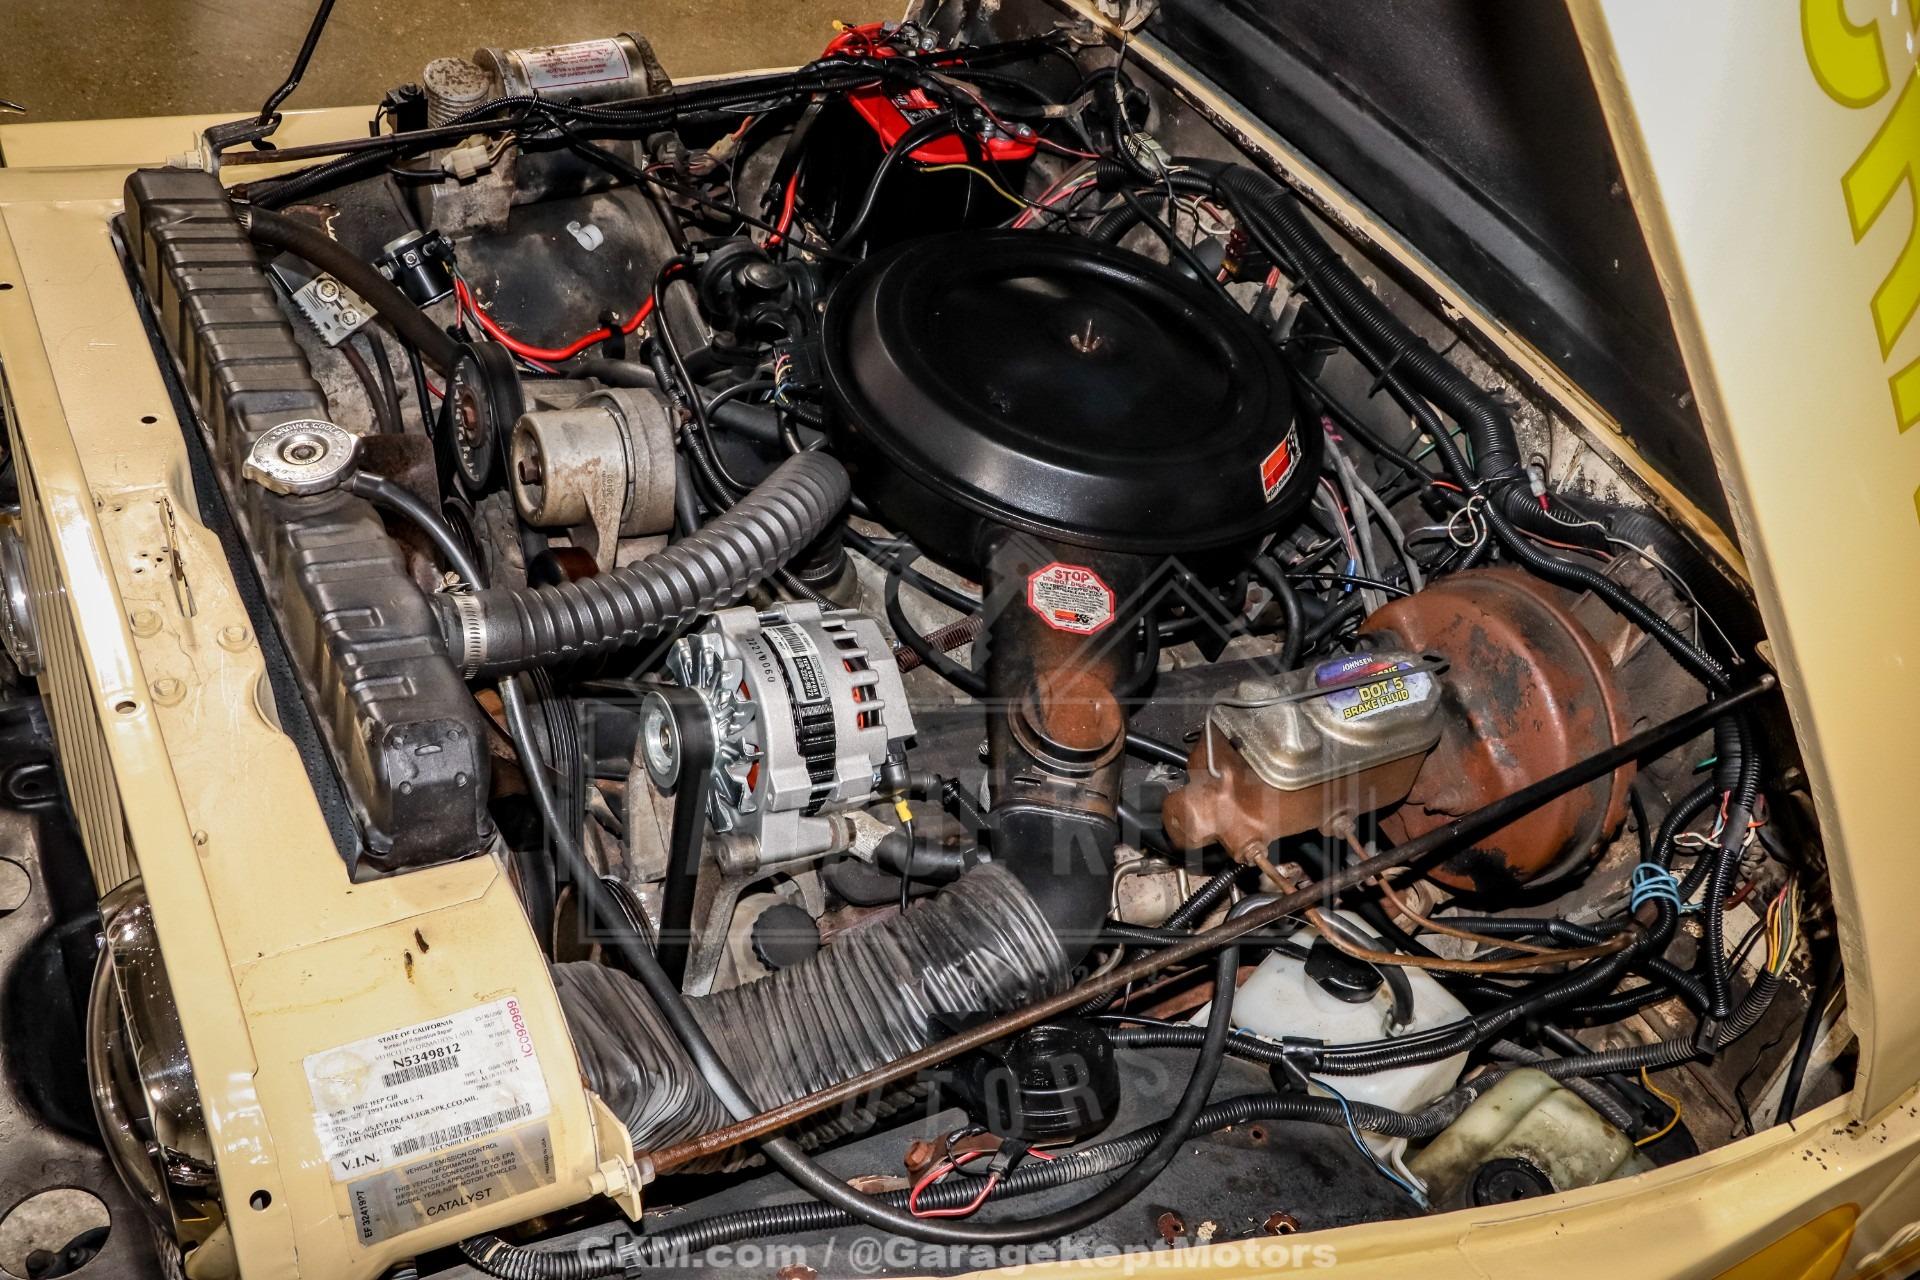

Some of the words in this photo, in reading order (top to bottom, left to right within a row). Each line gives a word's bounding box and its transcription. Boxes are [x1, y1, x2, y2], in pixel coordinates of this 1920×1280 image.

[1054, 569, 1090, 583] STOP
[1342, 656, 1374, 672] JOHNSEN
[1358, 681, 1389, 702] DOT
[1393, 676, 1404, 691] 5
[1343, 699, 1378, 720] BRAKE
[1378, 689, 1410, 708] FLUID
[377, 1033, 398, 1043] STATE
[411, 1018, 453, 1034] CALIFORNIA
[392, 1042, 461, 1069] N5349812
[363, 1124, 402, 1140] INJECTION
[340, 1151, 380, 1172] V.I.N.
[406, 1161, 434, 1175] VEHICLE
[434, 1151, 467, 1166] EMISSION
[467, 1141, 499, 1156] CONTROL
[430, 1156, 477, 1174] INFORMATION
[393, 1184, 410, 1193] THIS
[412, 1174, 440, 1187] VEHICLE
[440, 1162, 480, 1178] CONFORMS
[480, 1158, 490, 1166] TO
[502, 1151, 515, 1159] EPA
[446, 1167, 488, 1184] APPLICABLE
[396, 1195, 420, 1207] MODEL
[460, 1174, 484, 1186] MOTOR
[484, 1164, 517, 1178] VEHICLES
[426, 1187, 493, 1217] CATALYST
[364, 1227, 372, 1238] EF
